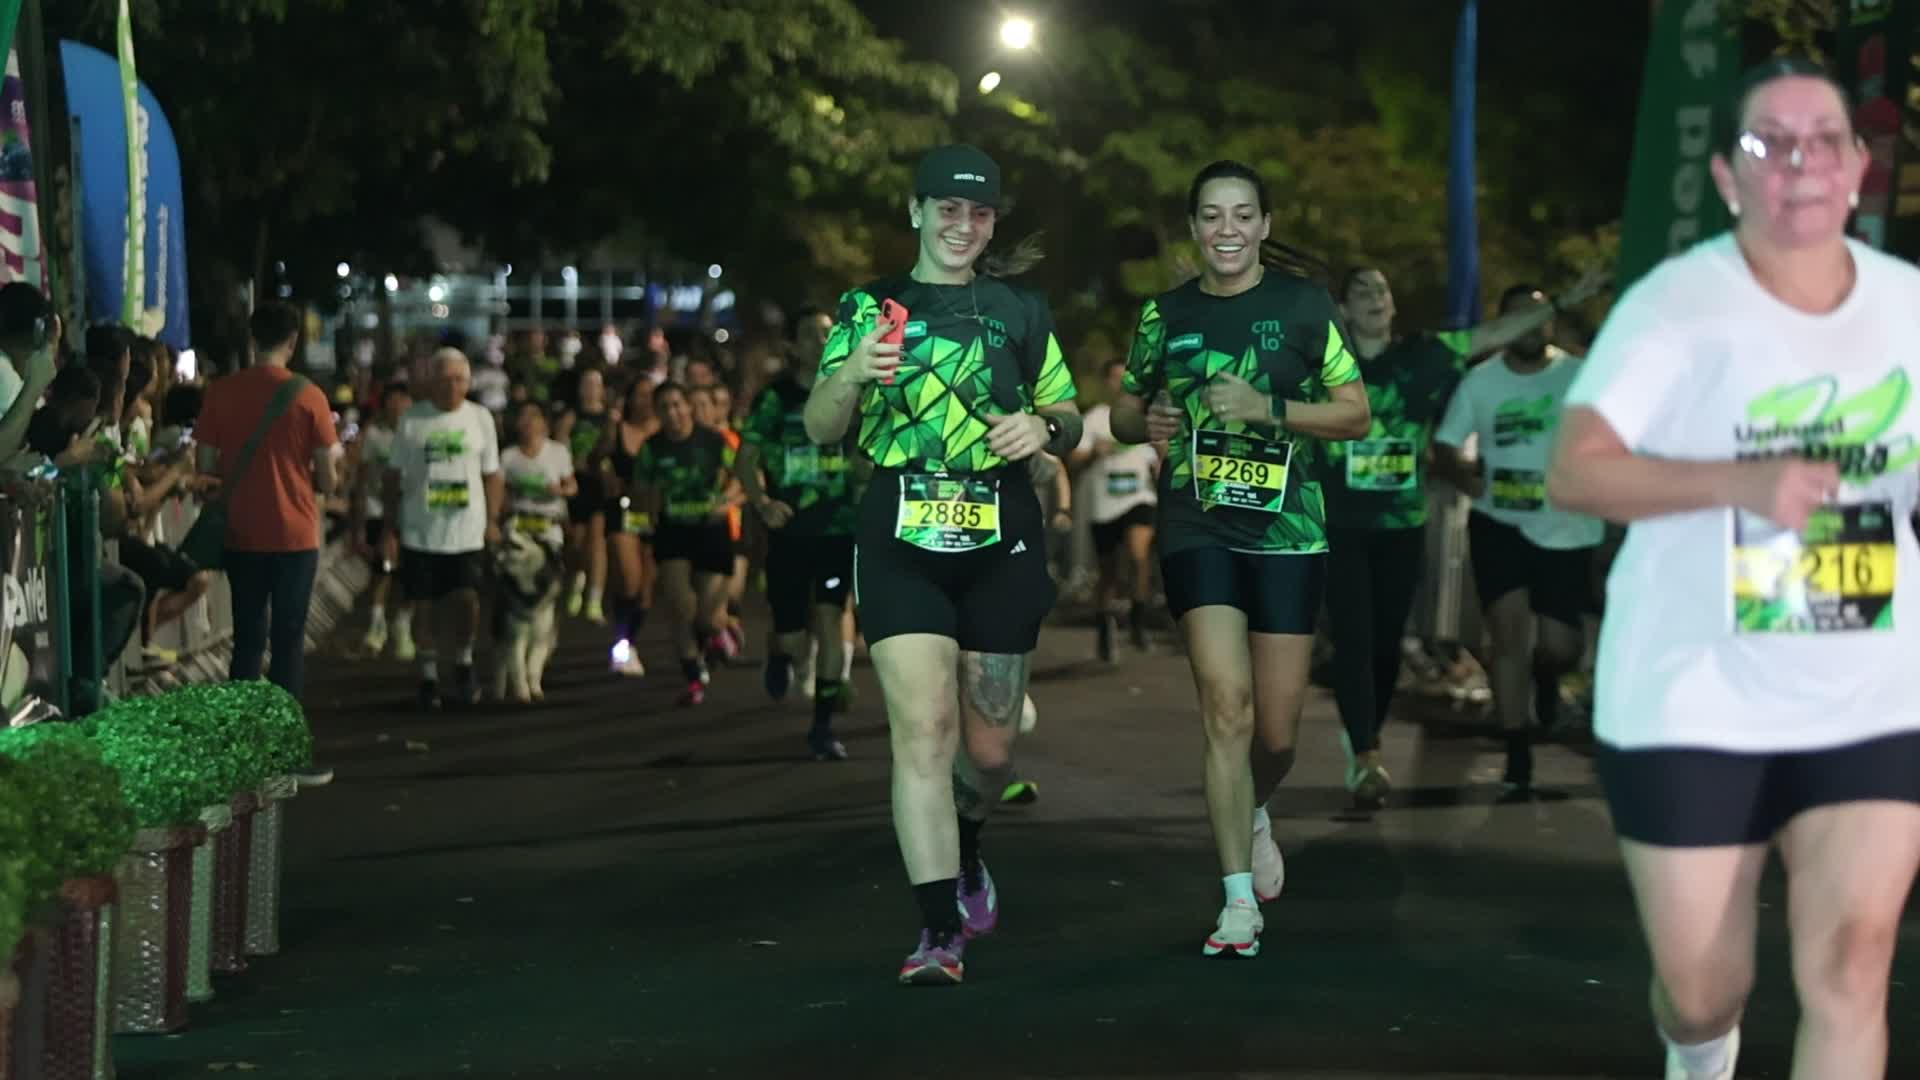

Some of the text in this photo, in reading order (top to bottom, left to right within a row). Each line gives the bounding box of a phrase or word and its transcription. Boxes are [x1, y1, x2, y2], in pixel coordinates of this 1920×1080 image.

[1251, 320, 1280, 334] cm
[1209, 457, 1269, 485] 2269
[919, 502, 981, 527] 2885
